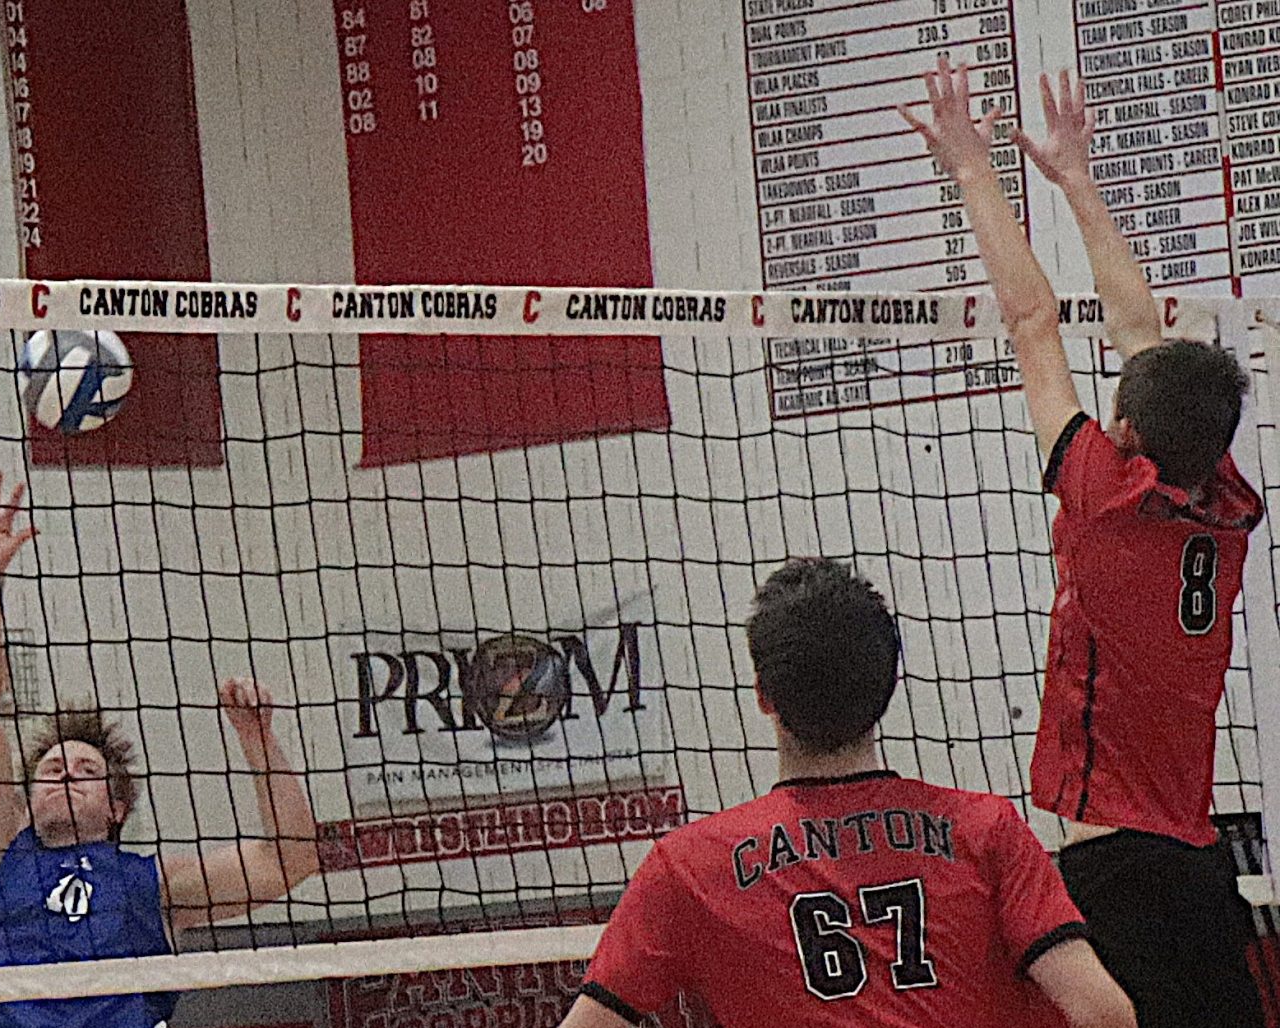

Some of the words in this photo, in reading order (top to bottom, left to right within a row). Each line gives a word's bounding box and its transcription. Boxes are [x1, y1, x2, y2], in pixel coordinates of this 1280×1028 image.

[6, 1, 23, 22] 01
[342, 8, 365, 29] 84
[411, 24, 434, 47] 82
[512, 24, 534, 47] 07
[1082, 26, 1108, 46] TEAM
[1110, 21, 1144, 41] POINTS
[1222, 29, 1265, 50] KONRAD
[345, 34, 366, 57] 87
[1084, 49, 1133, 73] TECHNICAL
[1136, 46, 1162, 64] FALLS
[1171, 39, 1209, 60] SEASON
[412, 46, 436, 70] 08
[514, 48, 539, 71] 08
[1224, 59, 1253, 79] RYAN
[346, 61, 370, 84] 88
[415, 72, 437, 95] 10
[516, 72, 541, 94] 09
[1086, 77, 1136, 101] TECHNICAL
[1138, 72, 1165, 92] FALLS
[1174, 65, 1210, 87] CAREER
[348, 87, 373, 111] 02
[1228, 83, 1270, 105] KONRAD
[419, 100, 438, 121] 11
[520, 95, 542, 117] 13
[1115, 101, 1160, 122] NEARFALL
[1169, 94, 1207, 115] SEASON
[349, 112, 376, 134] 08
[521, 119, 543, 141] 19
[1229, 112, 1259, 133] STEVE
[1116, 128, 1162, 150] NEARFALL
[1171, 121, 1209, 142] SEASON
[522, 143, 547, 166] 20
[1231, 138, 1275, 160] KONRAD
[1092, 158, 1138, 181] NEARFALL
[1140, 153, 1174, 174] POINTS
[1183, 146, 1220, 168] CAREER
[825, 171, 860, 192] SEASON
[1233, 168, 1252, 188] PAT
[1144, 180, 1181, 201] SEASON
[21, 201, 40, 223] 22
[840, 197, 875, 217] SEASON
[1237, 195, 1260, 215] ALEX
[1146, 207, 1181, 229] CAREER
[22, 226, 41, 248] 24
[842, 223, 877, 243] SEASON
[1159, 232, 1197, 254] SEASON
[1239, 223, 1257, 242] JOE
[945, 237, 965, 256] 327
[825, 252, 860, 272] SEASON
[945, 264, 967, 282] 505
[1162, 260, 1197, 281] CAREER
[31, 283, 50, 318] C
[79, 288, 169, 317] CANTON
[175, 290, 258, 319] COBRAS
[287, 288, 301, 321] C
[332, 292, 415, 319] CANTON
[421, 291, 497, 320] COBRAS
[522, 291, 541, 324] C
[565, 294, 647, 321] CANTON
[651, 295, 726, 323] COBRAS
[752, 296, 765, 327] C
[790, 297, 866, 324] CANTON
[870, 298, 939, 325] COBRAS
[963, 297, 976, 328] C
[1164, 297, 1178, 328] C
[1178, 532, 1218, 636] 8
[367, 770, 403, 785] PAIN
[577, 787, 683, 842] ROOM
[732, 808, 955, 891] CANTON
[789, 878, 938, 1000] 67
